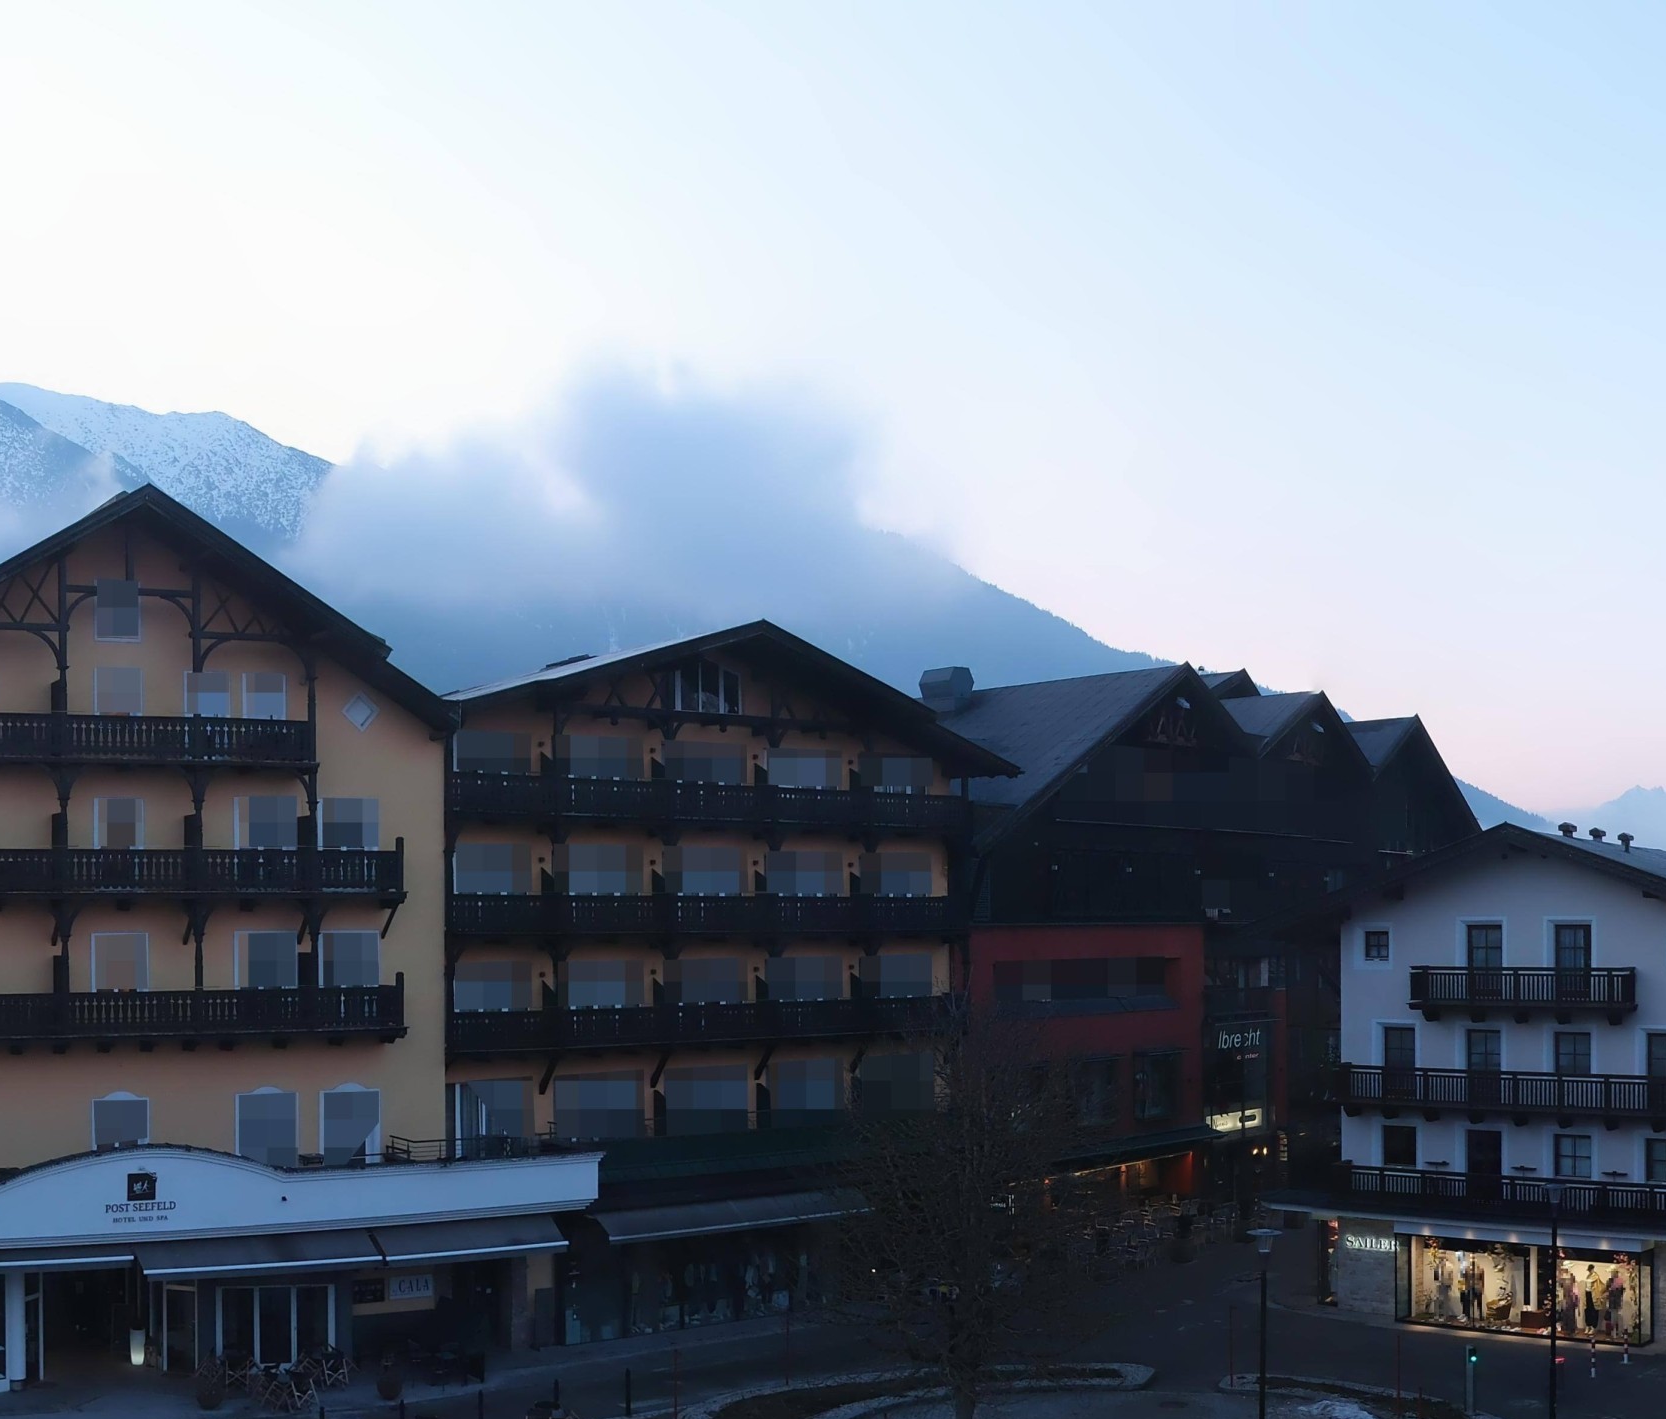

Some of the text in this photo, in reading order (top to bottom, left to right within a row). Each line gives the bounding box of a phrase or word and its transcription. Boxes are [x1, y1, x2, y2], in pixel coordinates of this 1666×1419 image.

[105, 1201, 176, 1213] POST SEEFELD
[1346, 1234, 1400, 1251] SAILER
[398, 1278, 429, 1293] CALA
